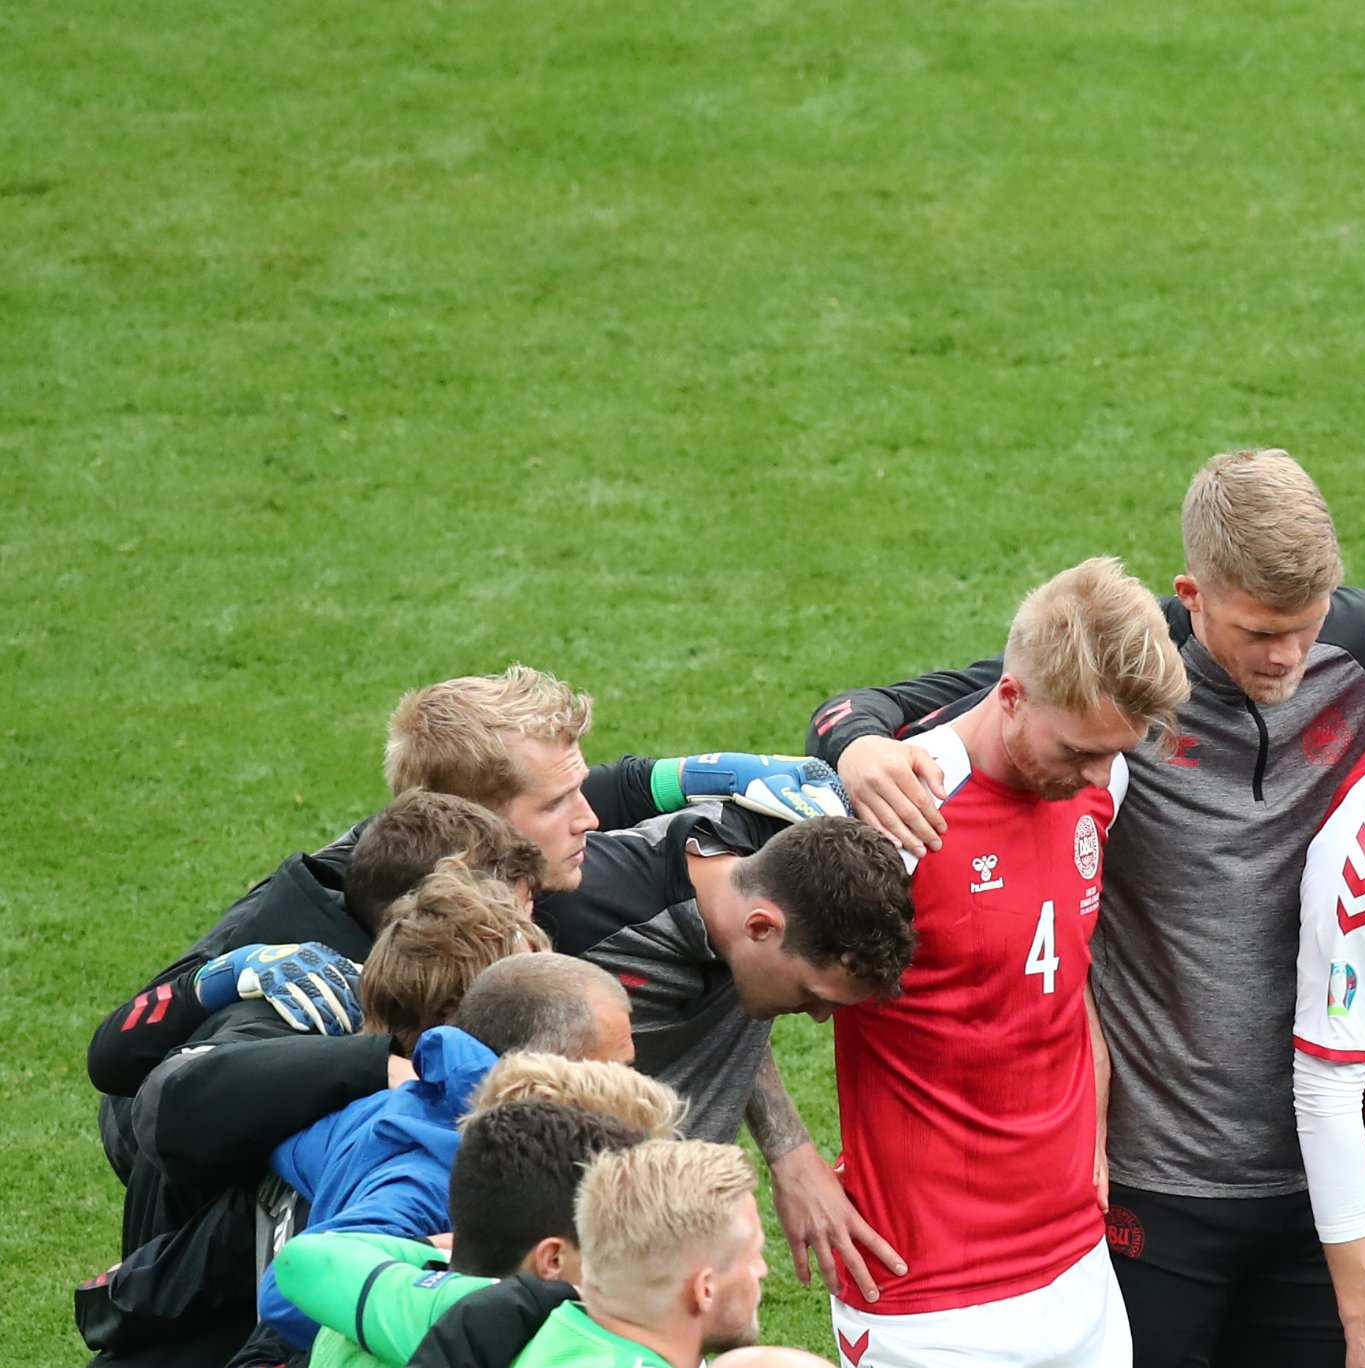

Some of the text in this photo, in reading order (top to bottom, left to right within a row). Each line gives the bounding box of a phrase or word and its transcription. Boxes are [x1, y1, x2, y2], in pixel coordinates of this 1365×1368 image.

[971, 877, 1004, 893] hummel
[1024, 900, 1060, 994] 4
[1108, 1225, 1130, 1245] BU
